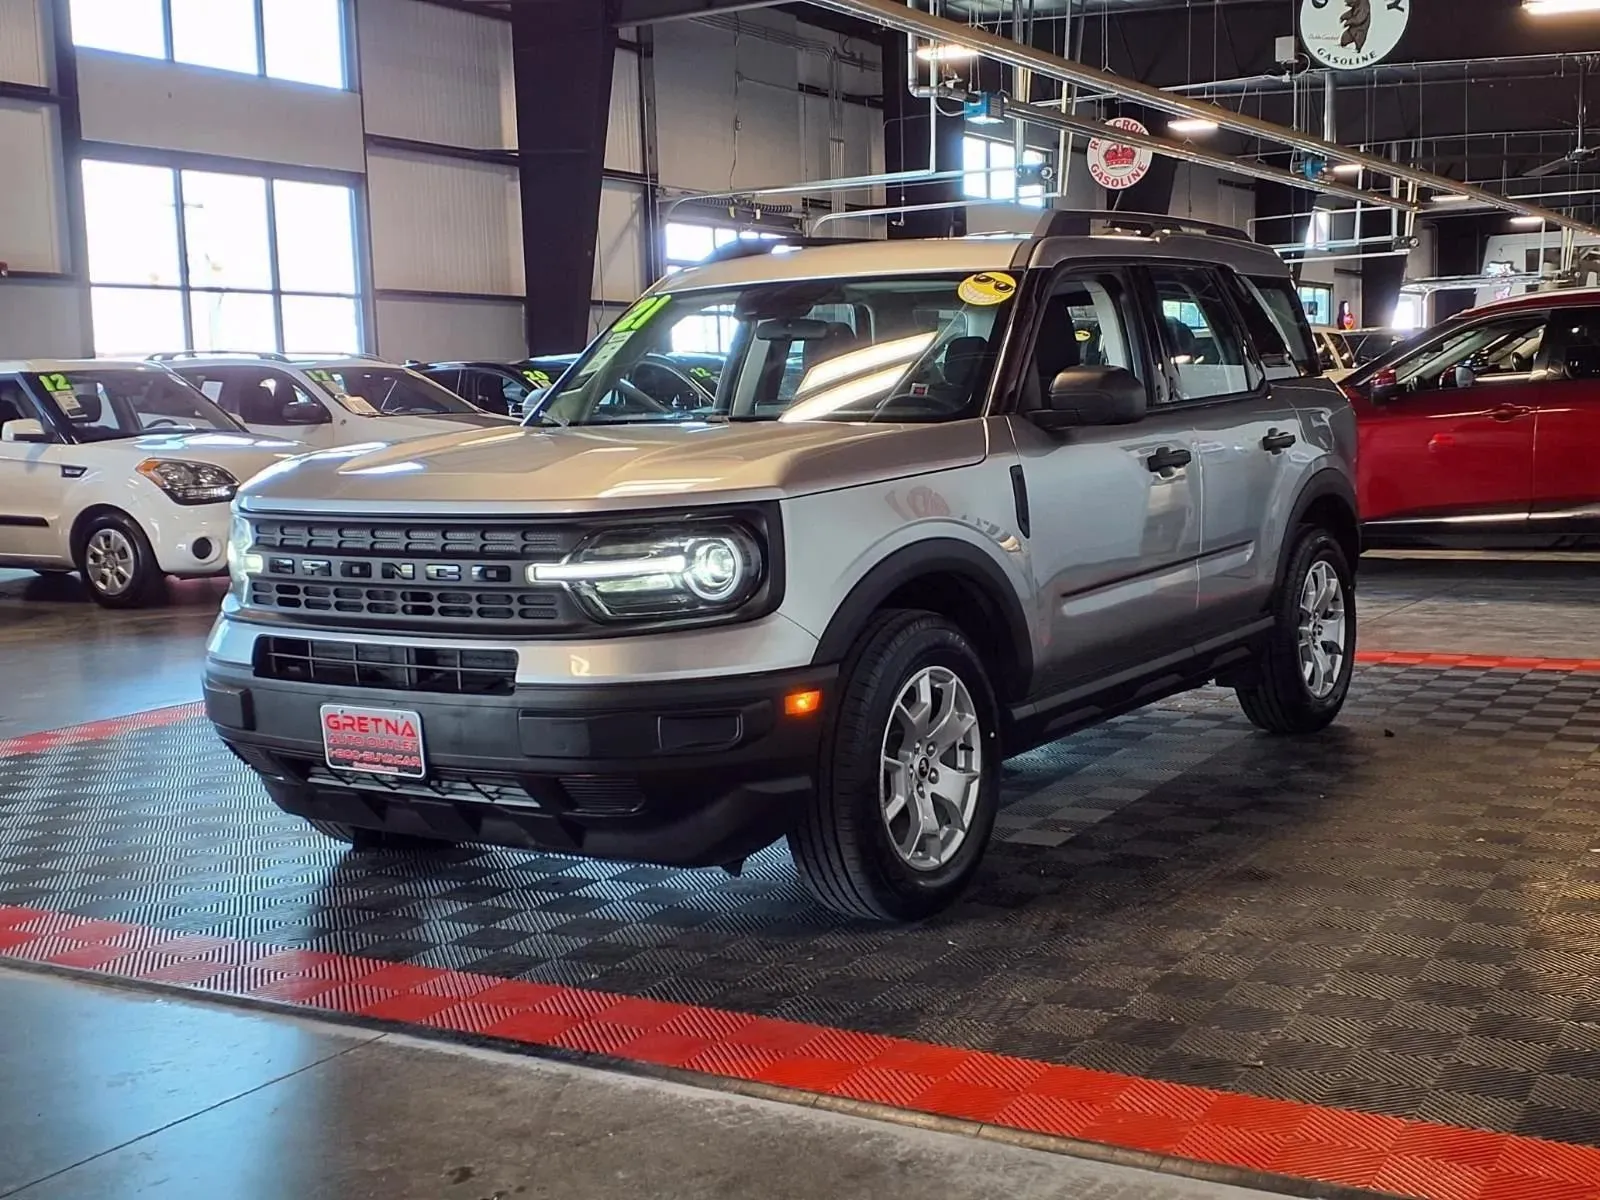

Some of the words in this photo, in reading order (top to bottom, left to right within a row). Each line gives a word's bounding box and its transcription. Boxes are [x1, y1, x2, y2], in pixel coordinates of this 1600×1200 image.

[1317, 48, 1377, 65] GASOLINE
[1091, 163, 1148, 188] GASOLINE
[38, 373, 72, 392] 12
[522, 370, 549, 380] 20
[268, 557, 512, 583] BRONCO
[326, 713, 416, 737] GRETNA
[328, 734, 364, 748] AUTO
[367, 737, 418, 753] OUTLET
